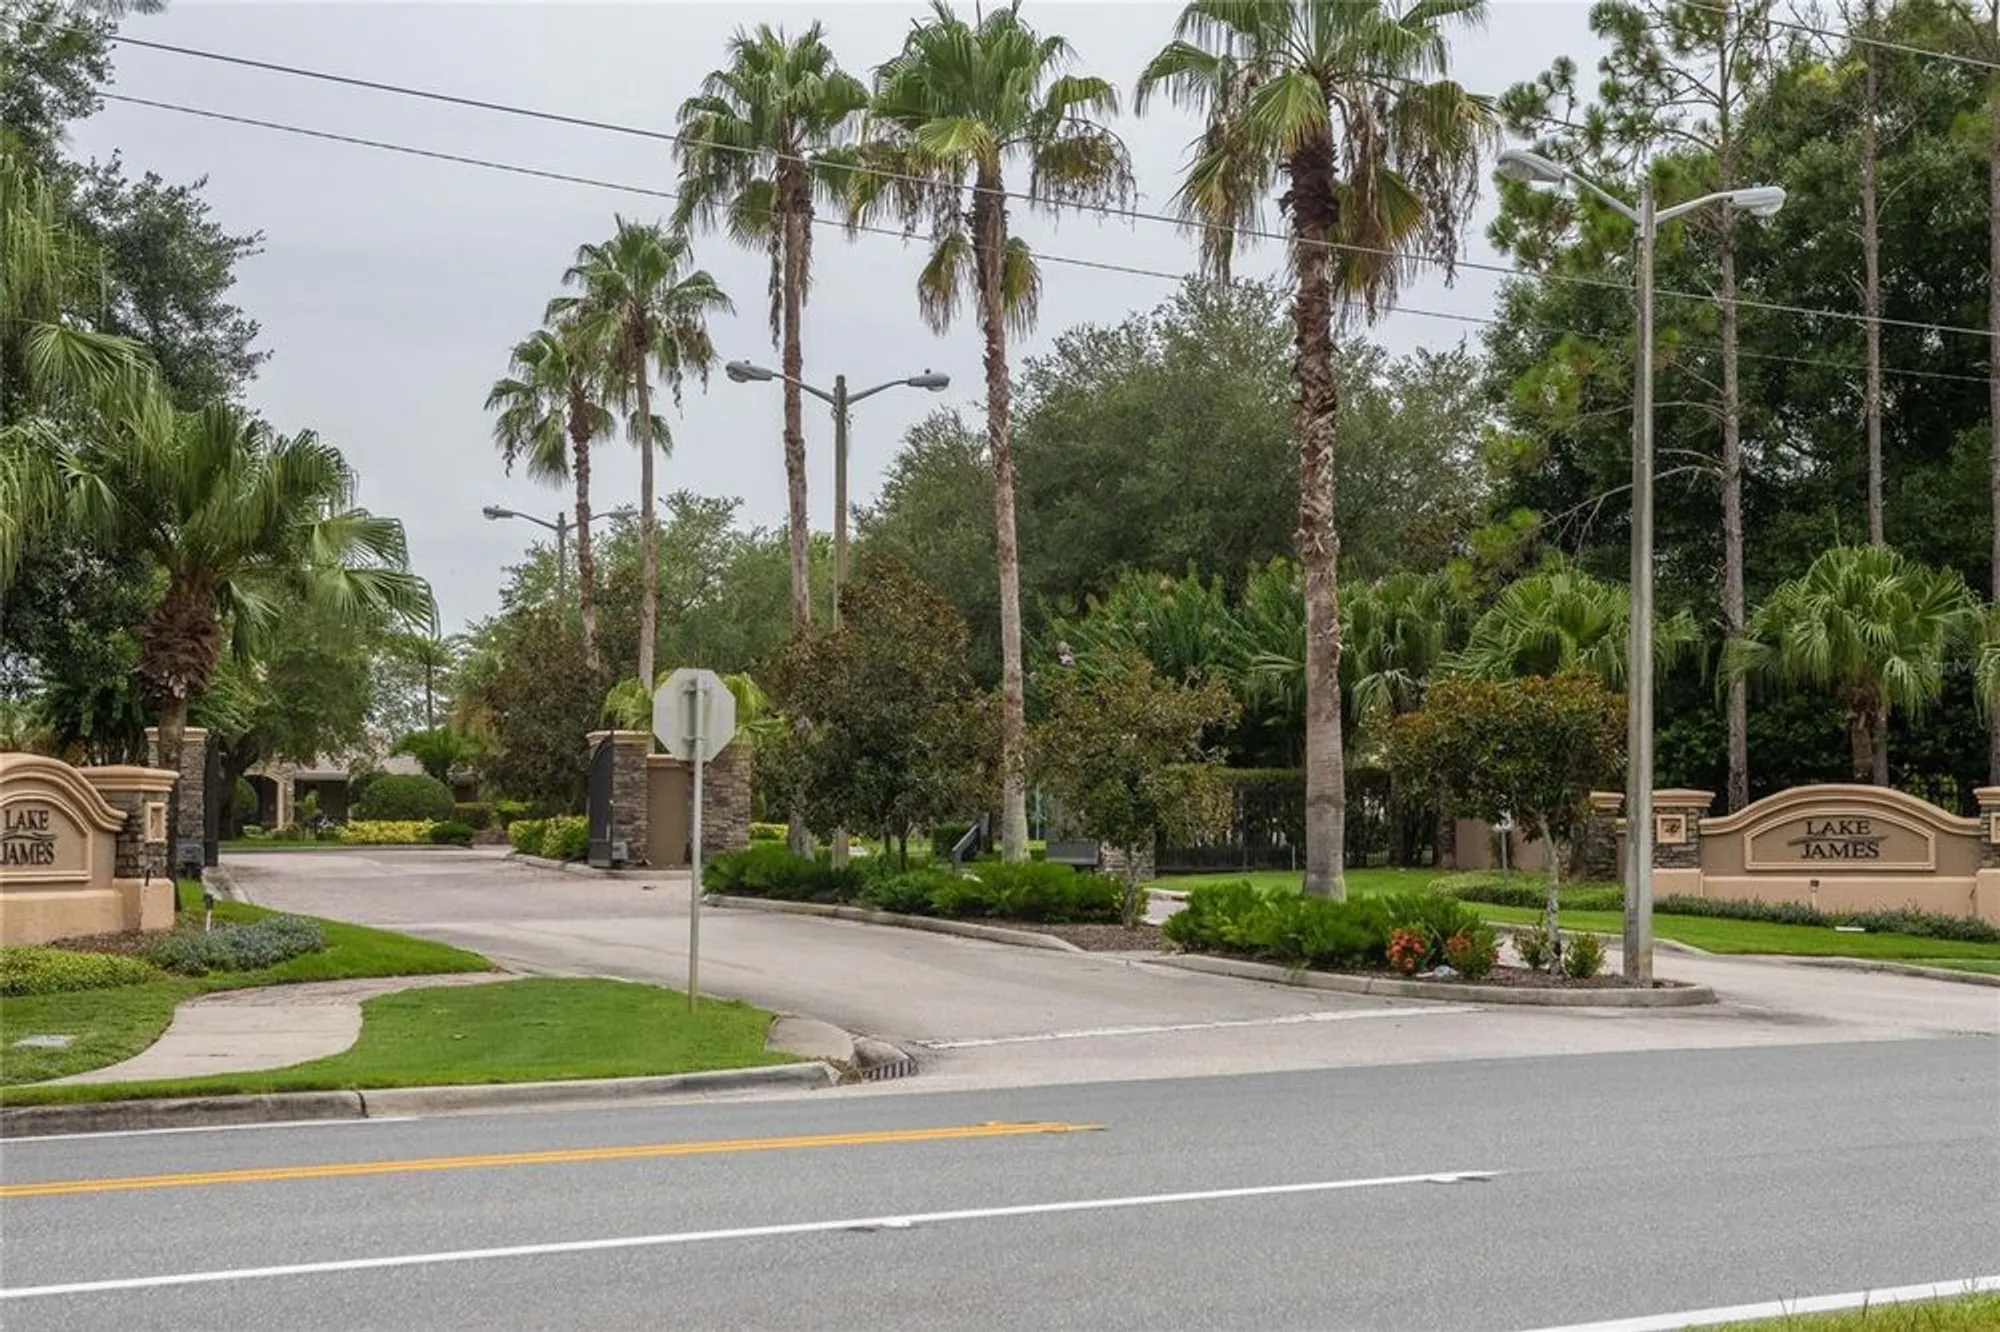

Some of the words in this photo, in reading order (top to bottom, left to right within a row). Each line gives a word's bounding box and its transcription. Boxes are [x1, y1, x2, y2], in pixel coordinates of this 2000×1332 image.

[4, 809, 49, 831] LAKE
[1806, 820, 1871, 835] LAKE
[0, 842, 55, 865] JAMES
[1801, 842, 1879, 859] JAMES
